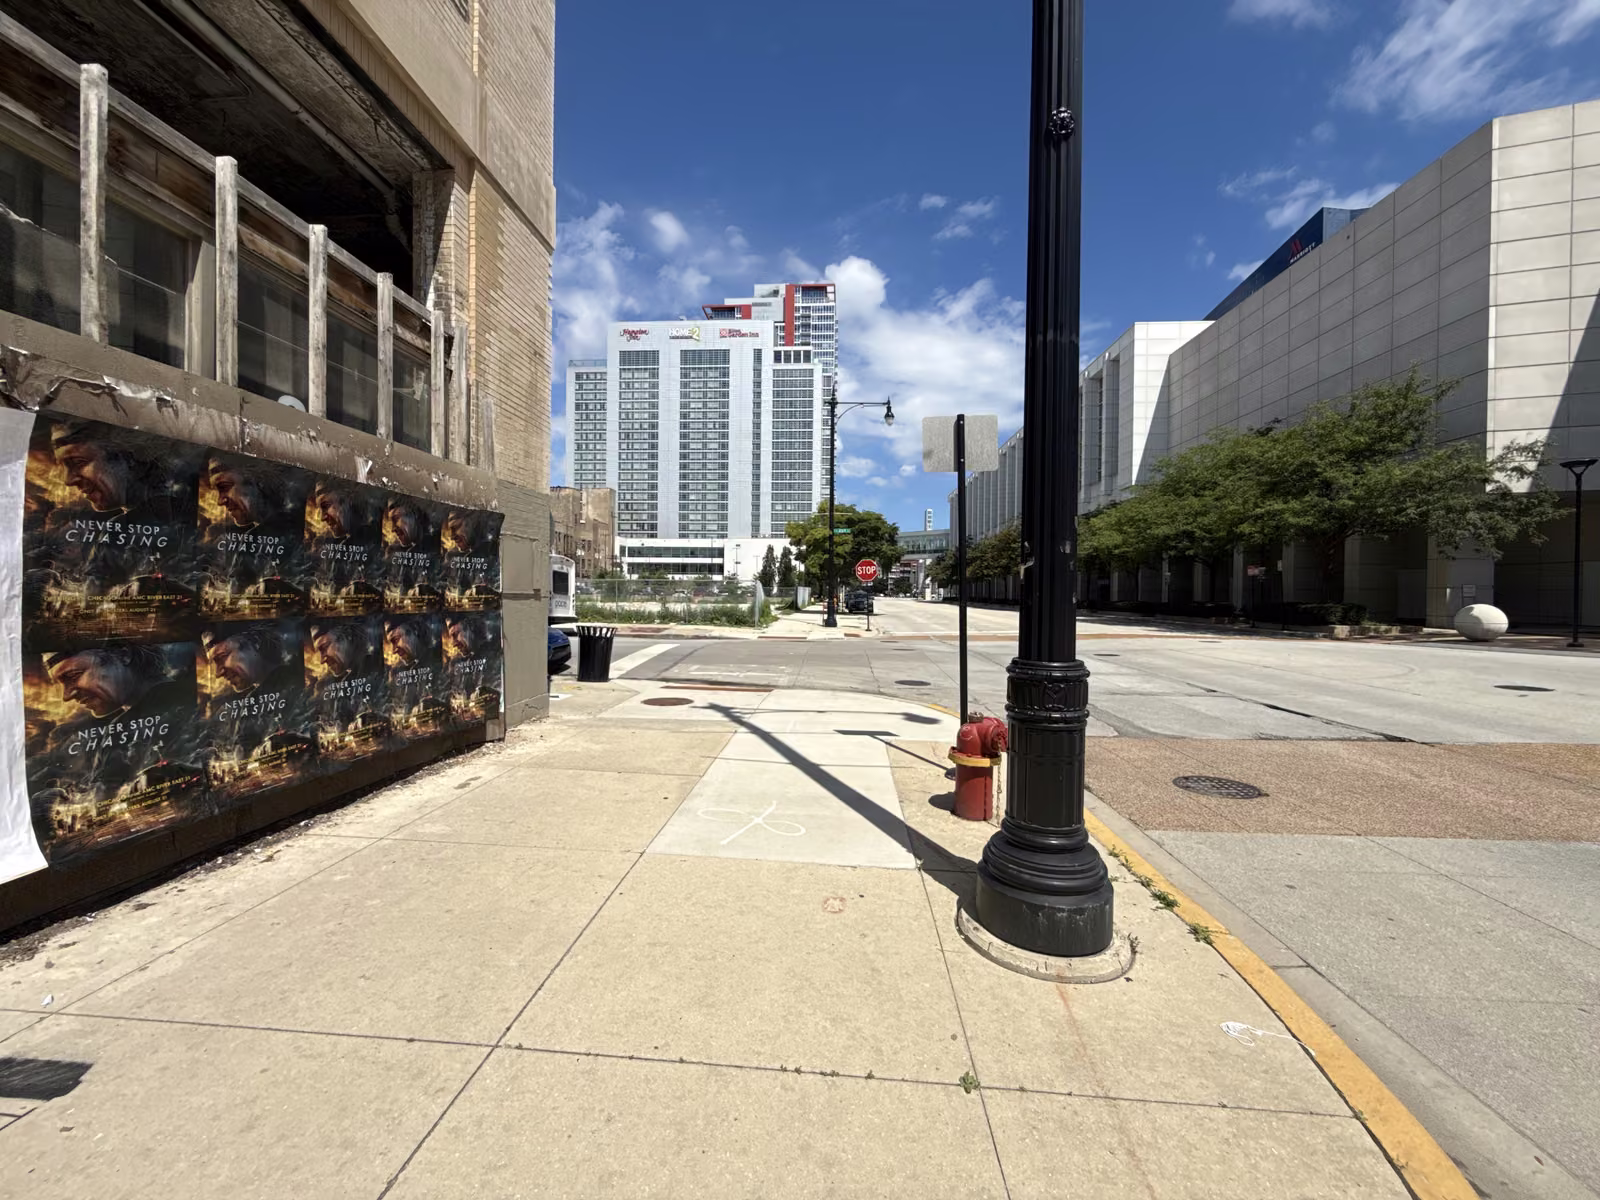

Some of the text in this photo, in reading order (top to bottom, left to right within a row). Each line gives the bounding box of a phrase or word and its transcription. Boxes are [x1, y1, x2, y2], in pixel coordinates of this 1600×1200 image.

[75, 519, 160, 535] NEVER STOP
[65, 529, 169, 548] CHASING
[225, 532, 279, 544] NEVER STOP
[217, 540, 285, 555] CHASING
[325, 543, 364, 553] NEVER STOP
[320, 550, 368, 561] CHASING
[391, 557, 430, 567] CHASING
[857, 566, 876, 575] STOP
[350, 677, 367, 687] STOP
[323, 683, 372, 700] CHASING
[225, 692, 280, 709] NEVER STOP
[219, 699, 286, 722] CHASING
[78, 715, 161, 740] NEVER STOP
[68, 723, 169, 755] CHASING
